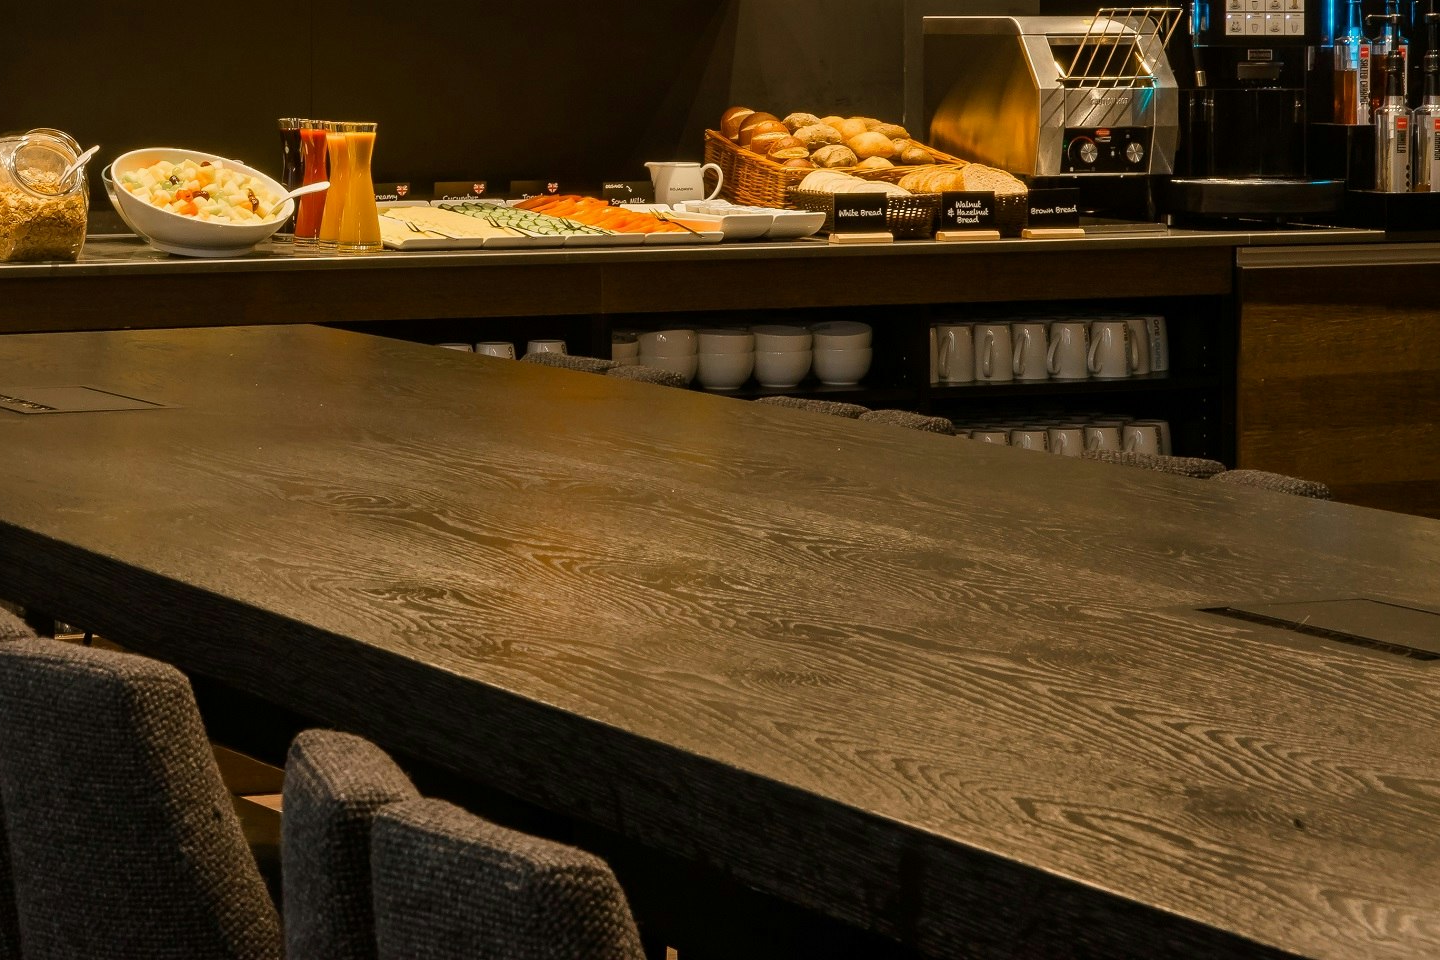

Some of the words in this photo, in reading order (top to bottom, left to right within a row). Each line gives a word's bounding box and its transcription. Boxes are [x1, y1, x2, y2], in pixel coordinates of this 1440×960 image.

[956, 201, 981, 209] Walnut
[1030, 207, 1053, 215] Brown
[1056, 204, 1077, 214] Bread
[838, 209, 859, 217] White
[861, 208, 882, 217] Bread
[947, 209, 955, 217] &
[957, 208, 989, 216] Hazelnut
